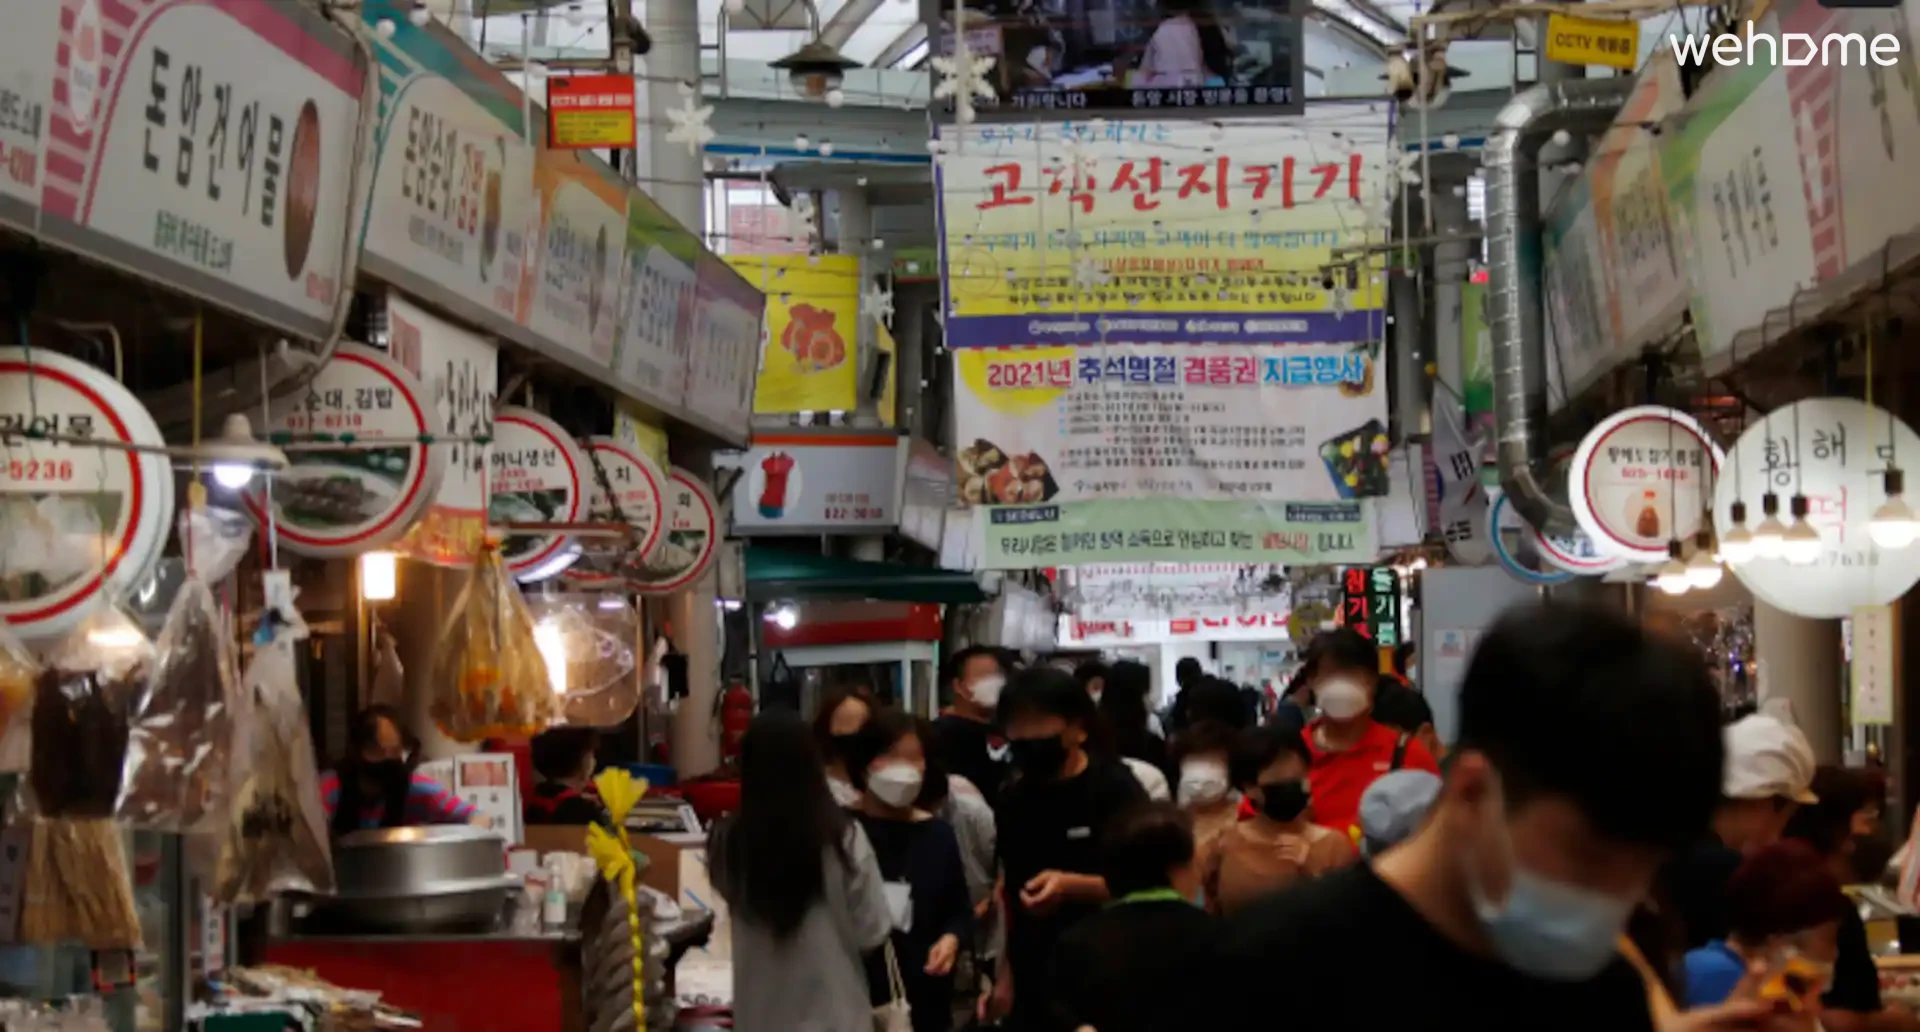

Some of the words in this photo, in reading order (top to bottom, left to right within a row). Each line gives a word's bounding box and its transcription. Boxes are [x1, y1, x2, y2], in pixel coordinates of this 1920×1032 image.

[143, 46, 284, 228] 돈암건어물
[986, 360, 1073, 388] 2021년
[1077, 356, 1177, 386] 추석명절
[1263, 355, 1365, 385] 지급행사
[1127, 531, 1175, 549] 소독으로
